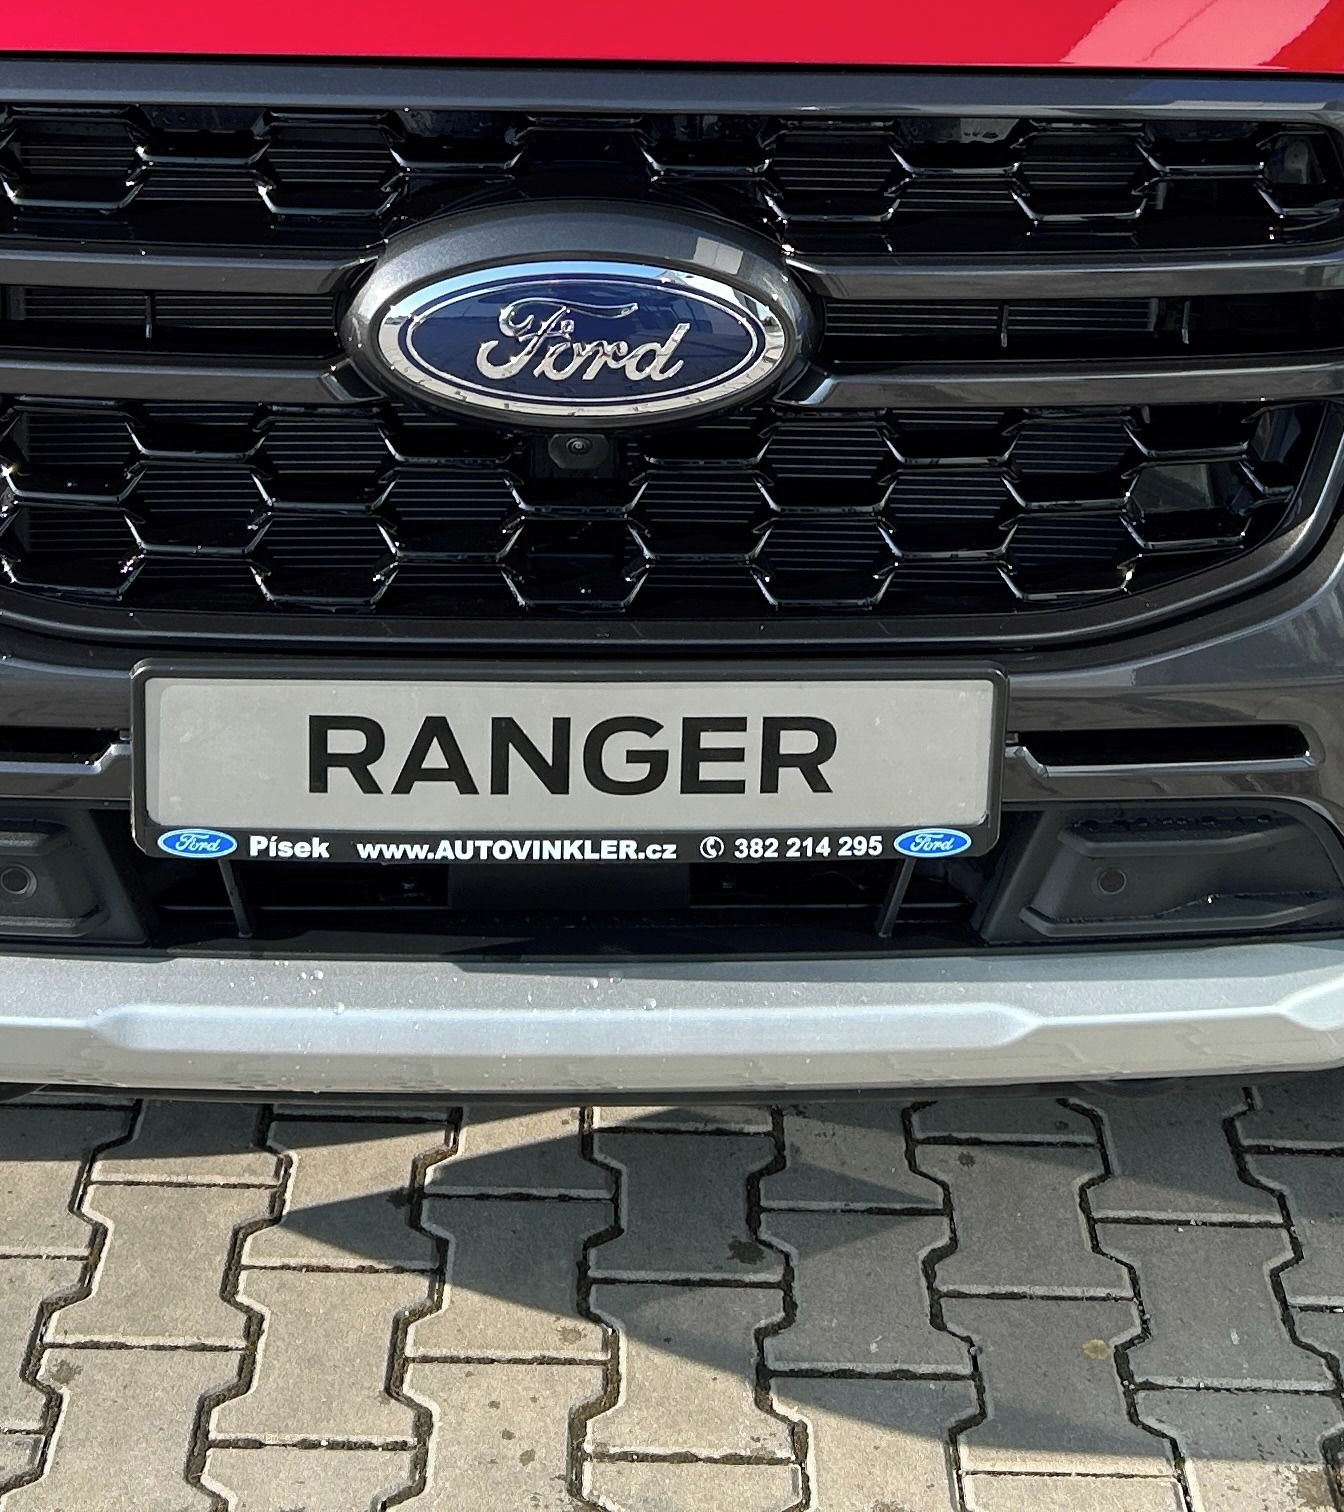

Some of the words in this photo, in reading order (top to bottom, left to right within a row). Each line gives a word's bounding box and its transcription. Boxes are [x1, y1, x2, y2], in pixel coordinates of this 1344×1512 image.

[476, 297, 691, 382] Ford
[307, 714, 839, 796] RANGER
[175, 833, 222, 853] Ford
[248, 834, 330, 859] Písek
[356, 838, 677, 861] www.AUTOVINKLER.cz
[734, 836, 779, 859] 382
[786, 836, 832, 858] 214
[837, 834, 884, 857] 295
[910, 832, 956, 854] Ford
